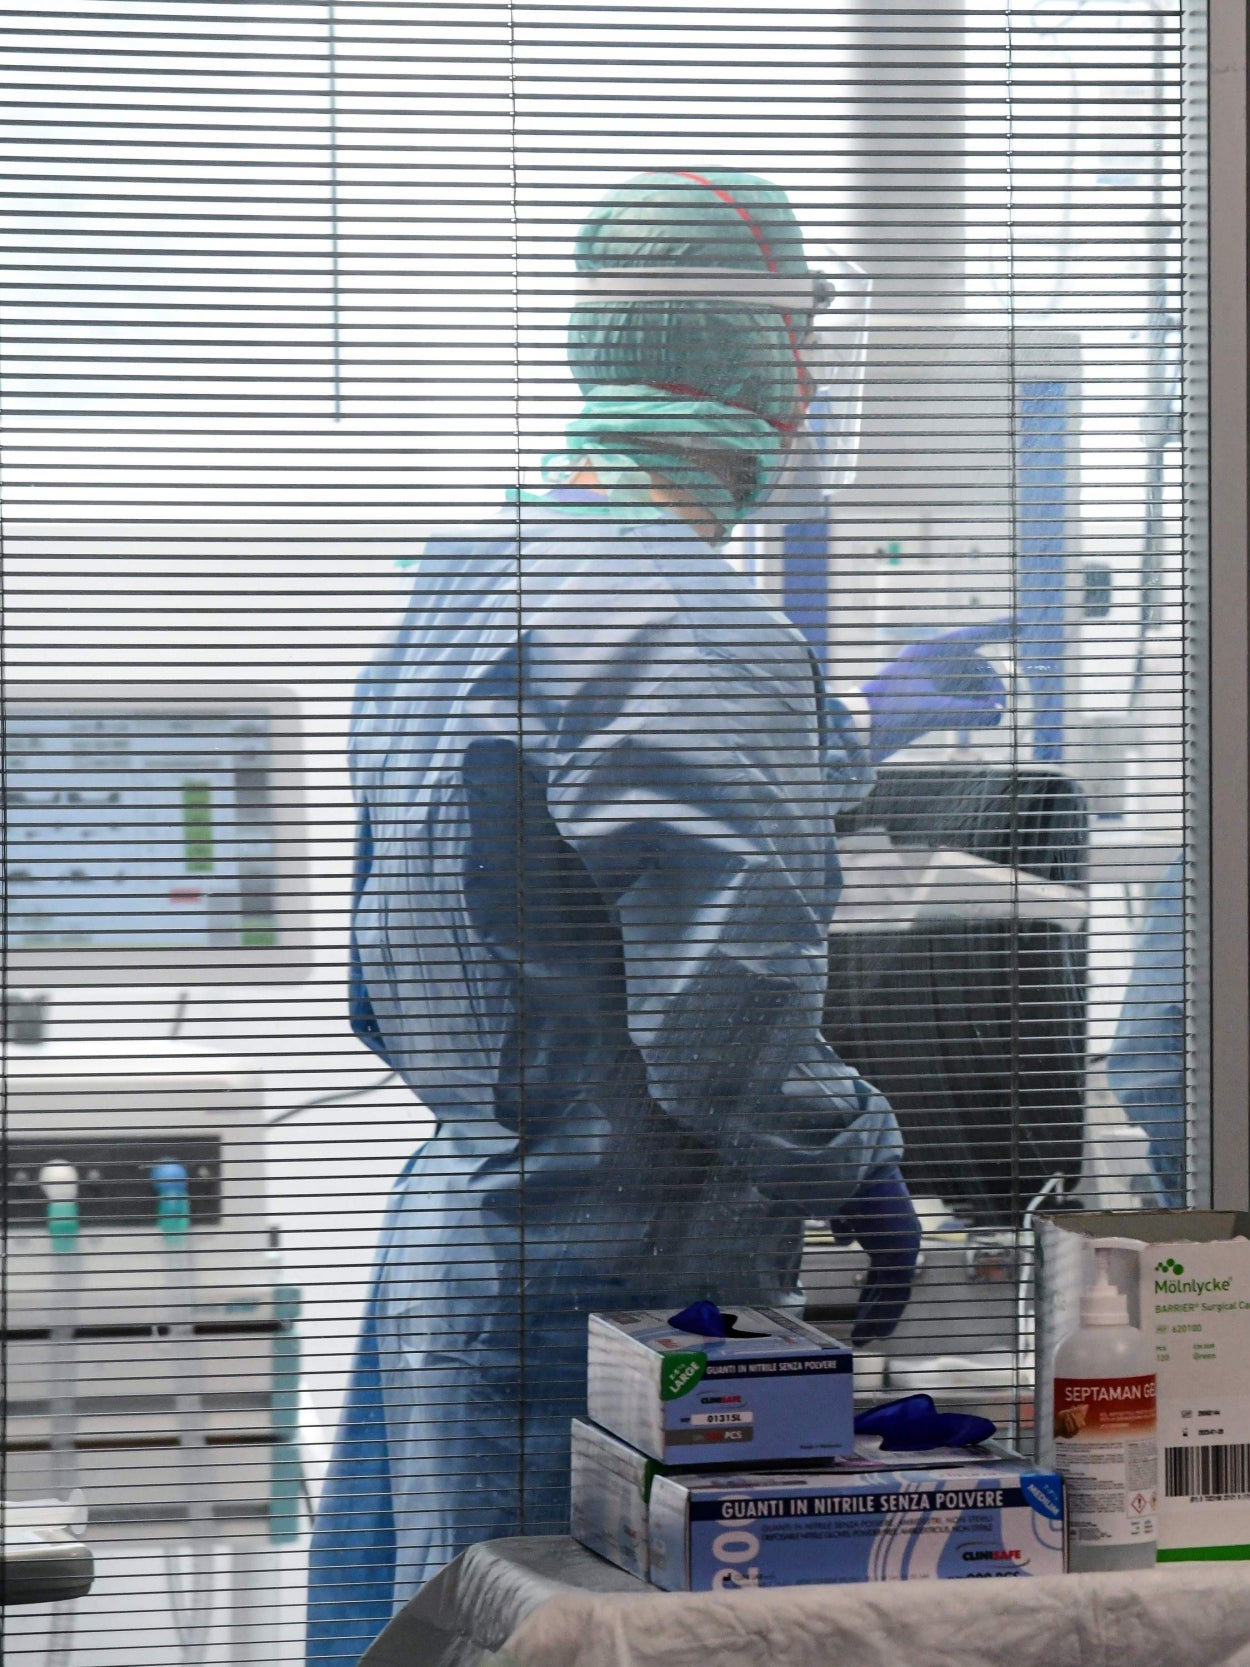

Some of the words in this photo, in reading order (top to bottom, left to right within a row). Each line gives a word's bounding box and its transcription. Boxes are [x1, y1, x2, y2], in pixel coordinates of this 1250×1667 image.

[1201, 1302, 1237, 1313] Surgical
[706, 1364, 736, 1376] GUANTI
[737, 1363, 747, 1374] IN
[749, 1362, 777, 1374] NITRILE
[779, 1361, 803, 1372] SENZA
[804, 1359, 838, 1371] POLVERE
[668, 1361, 700, 1393] LARGE
[1064, 1384, 1142, 1402] SEPTAMAN
[724, 1430, 743, 1440] PCS
[721, 1500, 784, 1519] GUANTI
[790, 1499, 809, 1515] IN
[814, 1496, 874, 1514] NITRILE
[880, 1493, 931, 1511] SENZA
[935, 1490, 1004, 1509] POLVERE
[961, 1549, 1022, 1562] CLINISAFE
